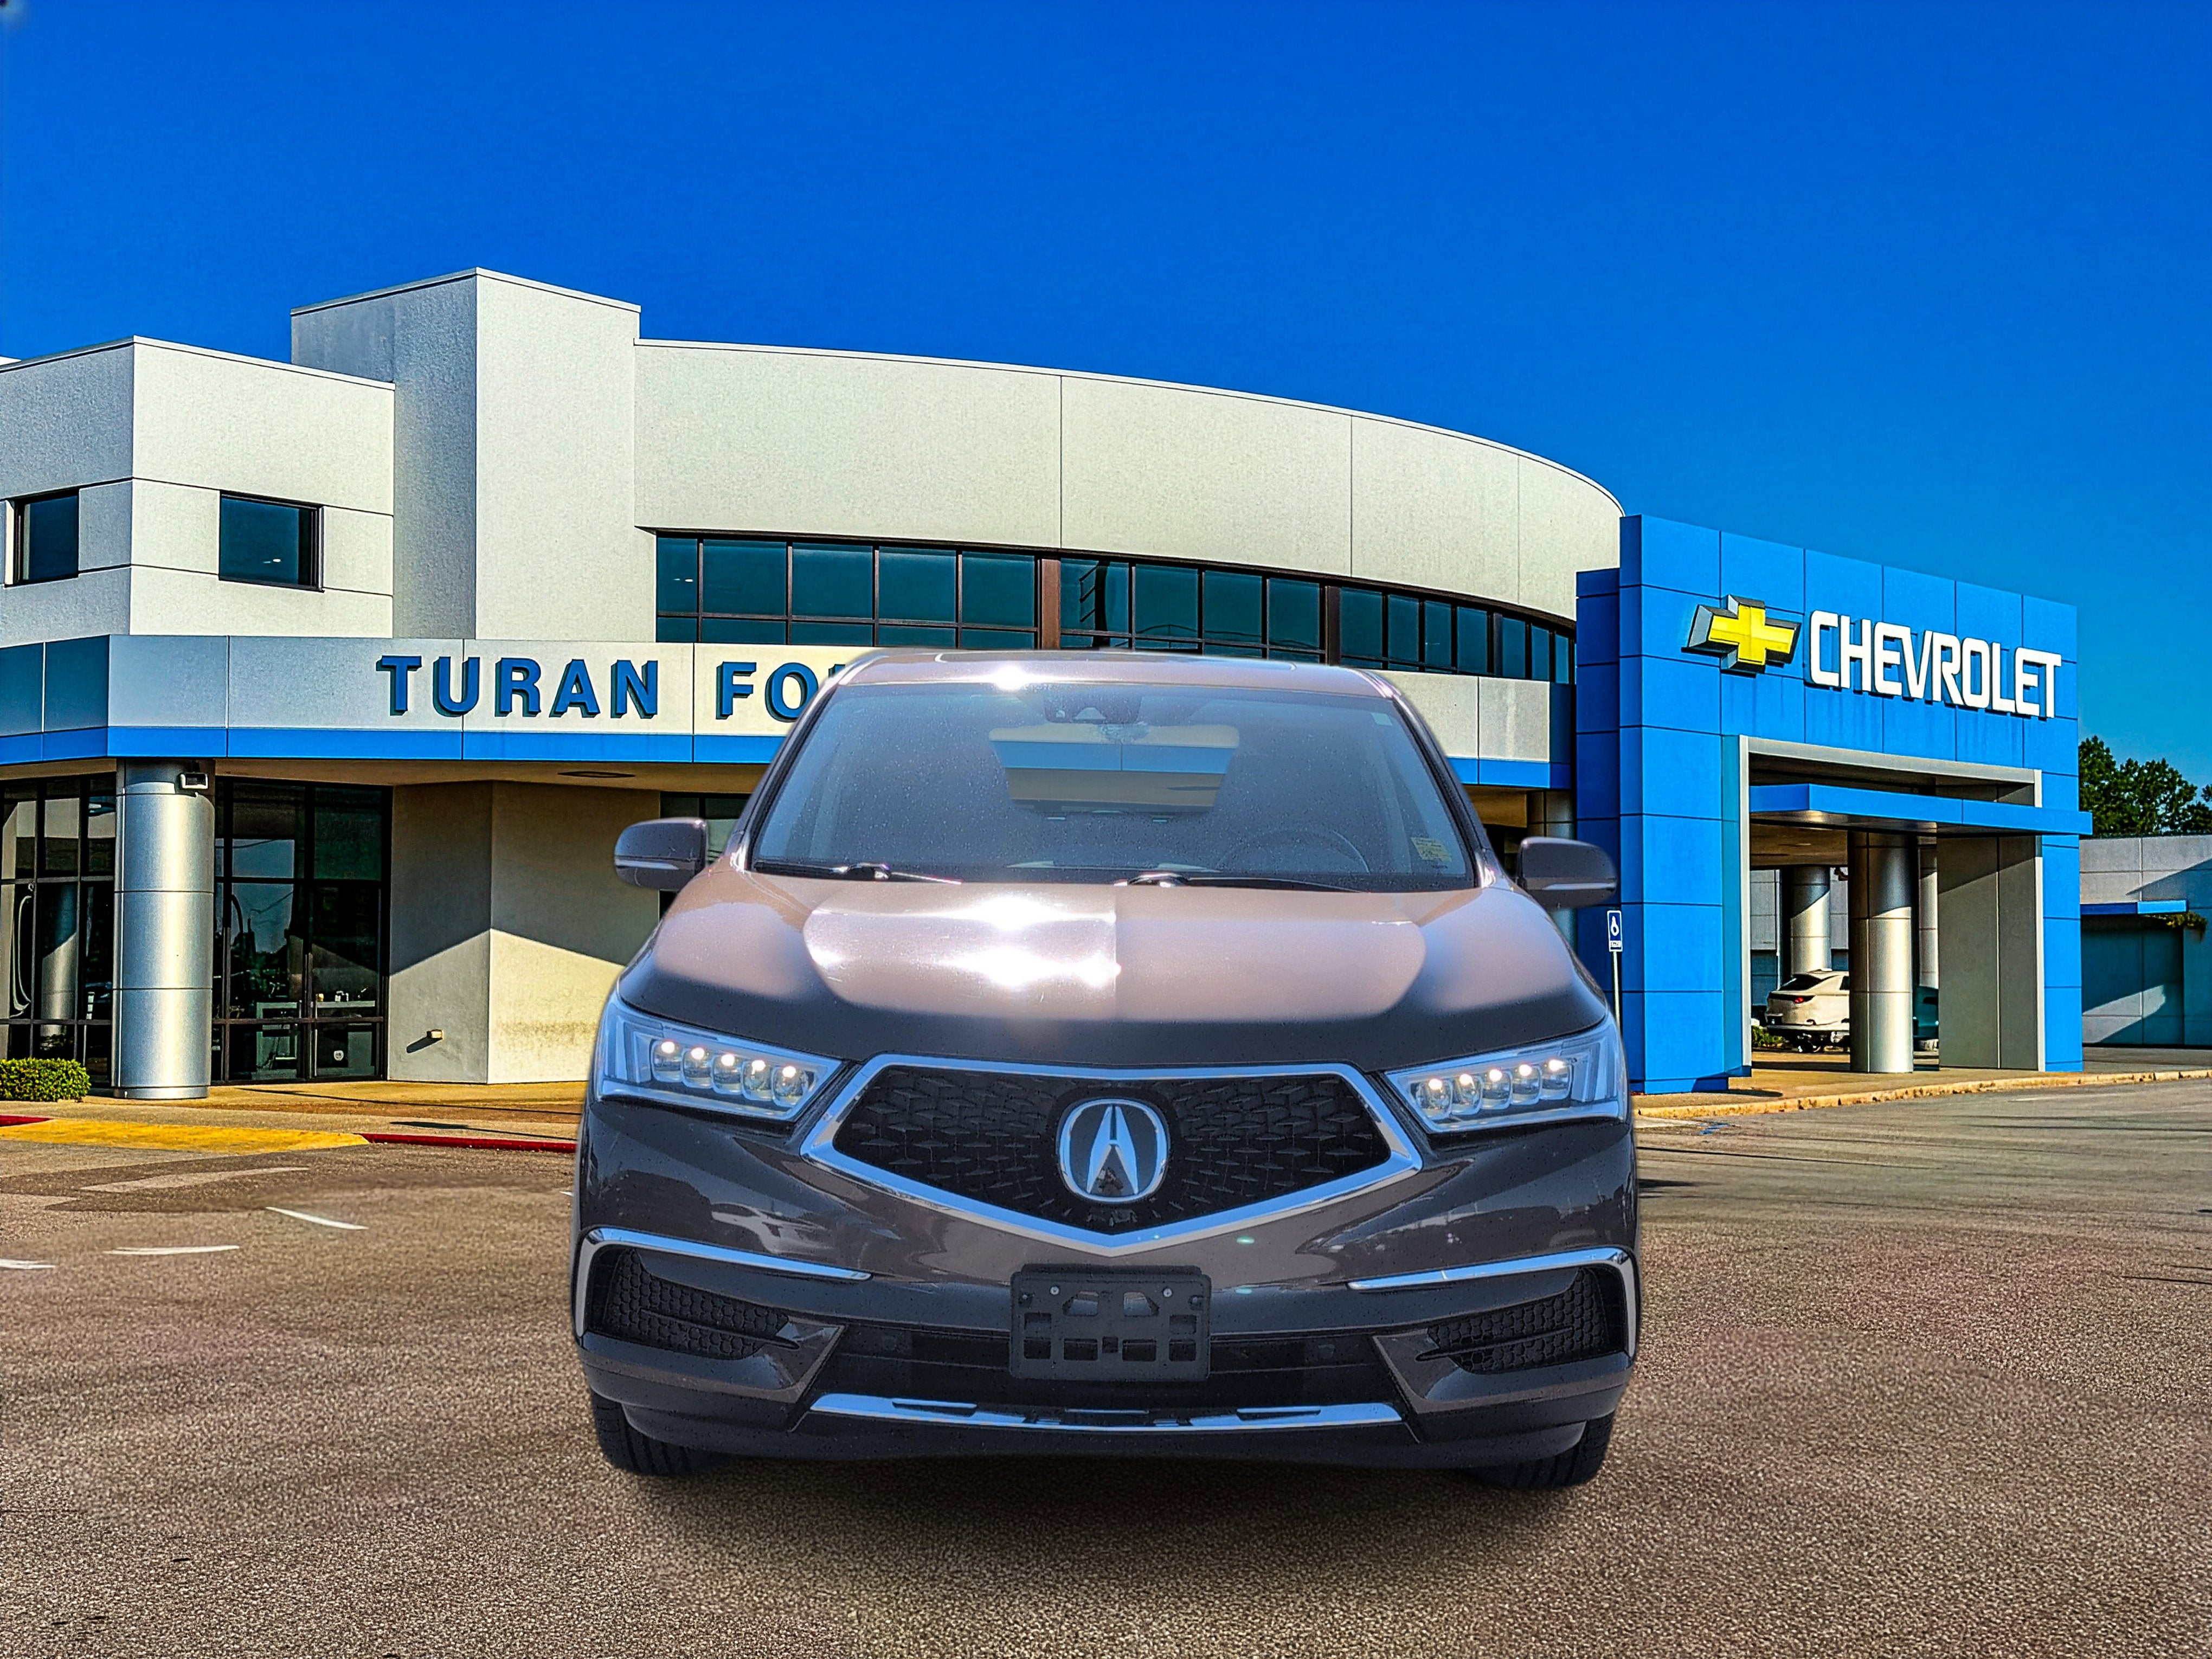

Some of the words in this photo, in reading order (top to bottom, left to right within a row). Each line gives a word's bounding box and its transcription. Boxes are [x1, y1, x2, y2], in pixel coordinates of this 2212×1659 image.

[376, 654, 658, 719] TURAN
[716, 661, 846, 723] FO
[1810, 610, 2062, 718] CHEVROLET
